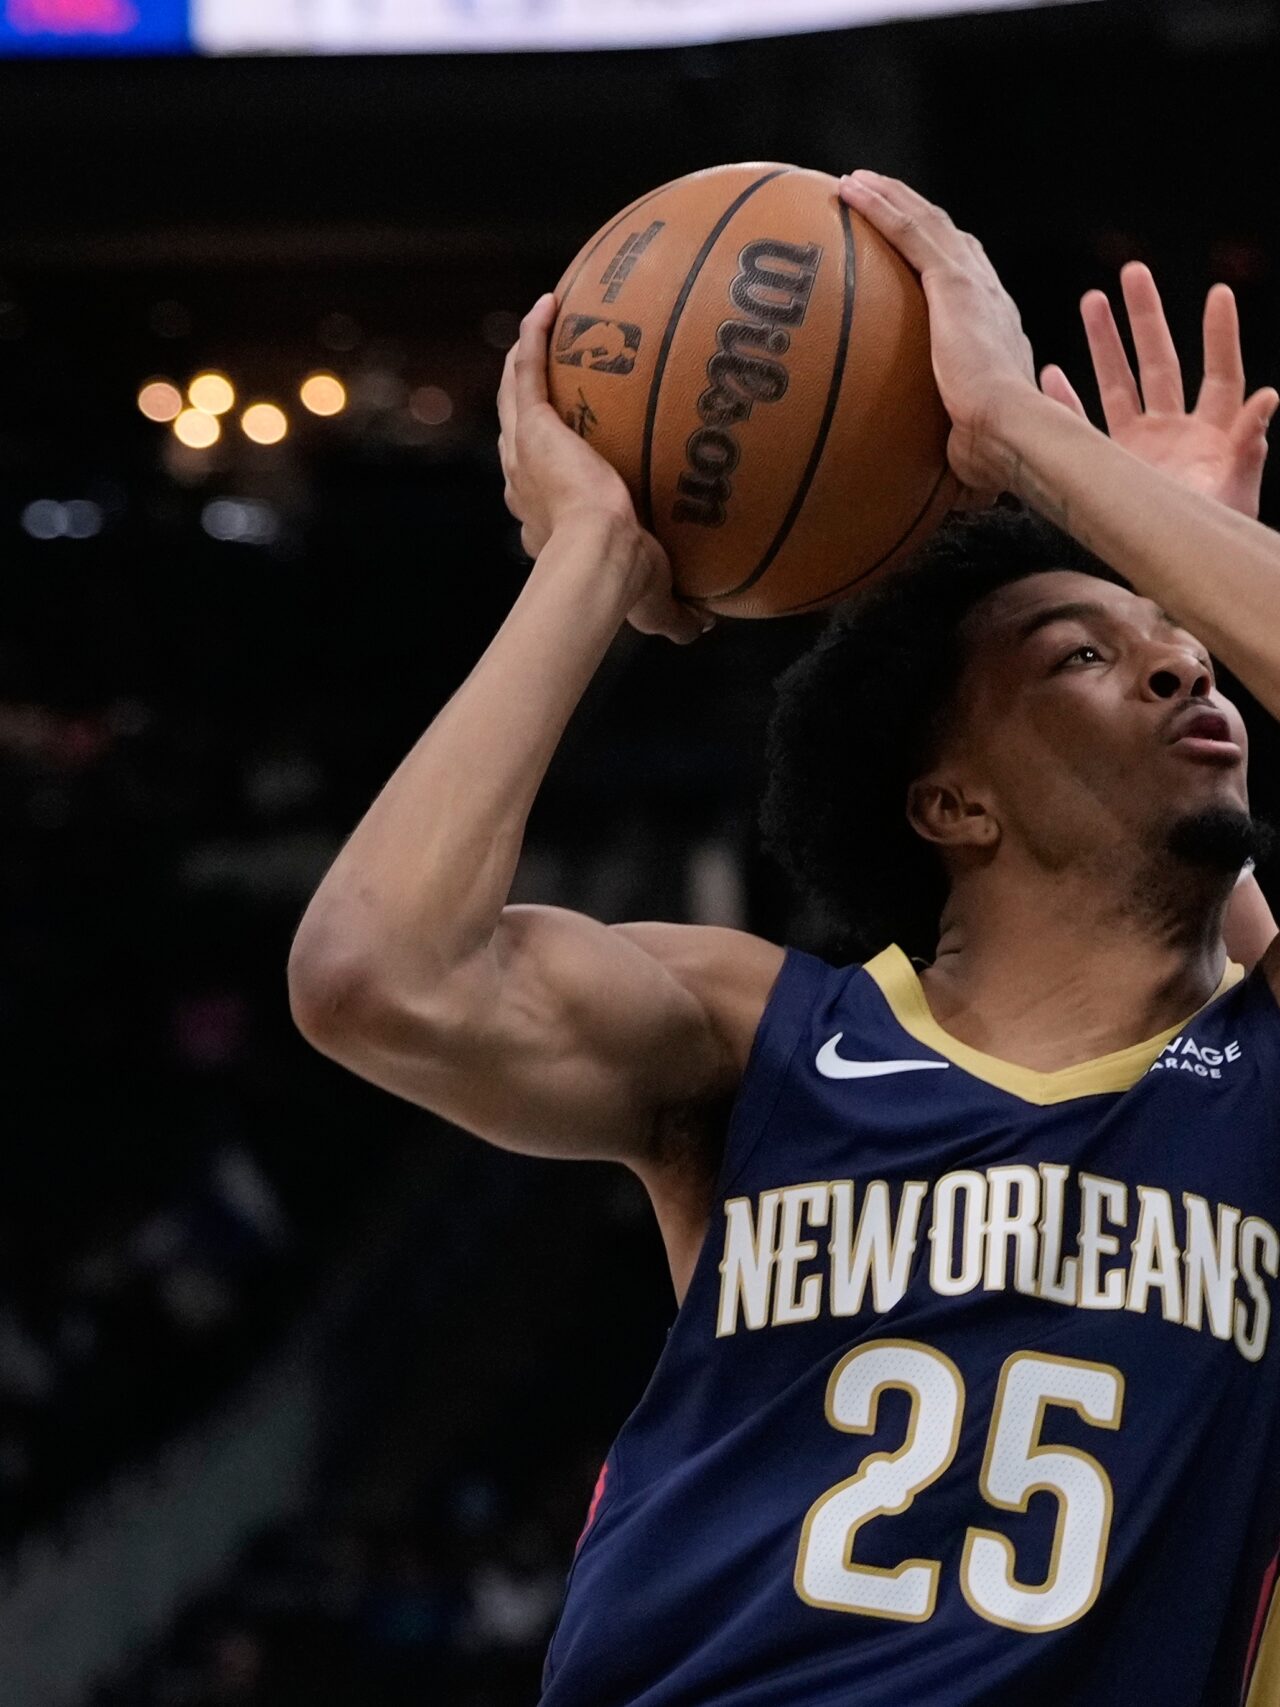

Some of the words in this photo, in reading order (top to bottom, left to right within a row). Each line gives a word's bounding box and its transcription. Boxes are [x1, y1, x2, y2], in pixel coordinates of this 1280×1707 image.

[672, 237, 824, 528] Wilson
[715, 1179, 927, 1338] NEW
[928, 1161, 1280, 1363] ORLEANS
[793, 1338, 1126, 1634] 25
